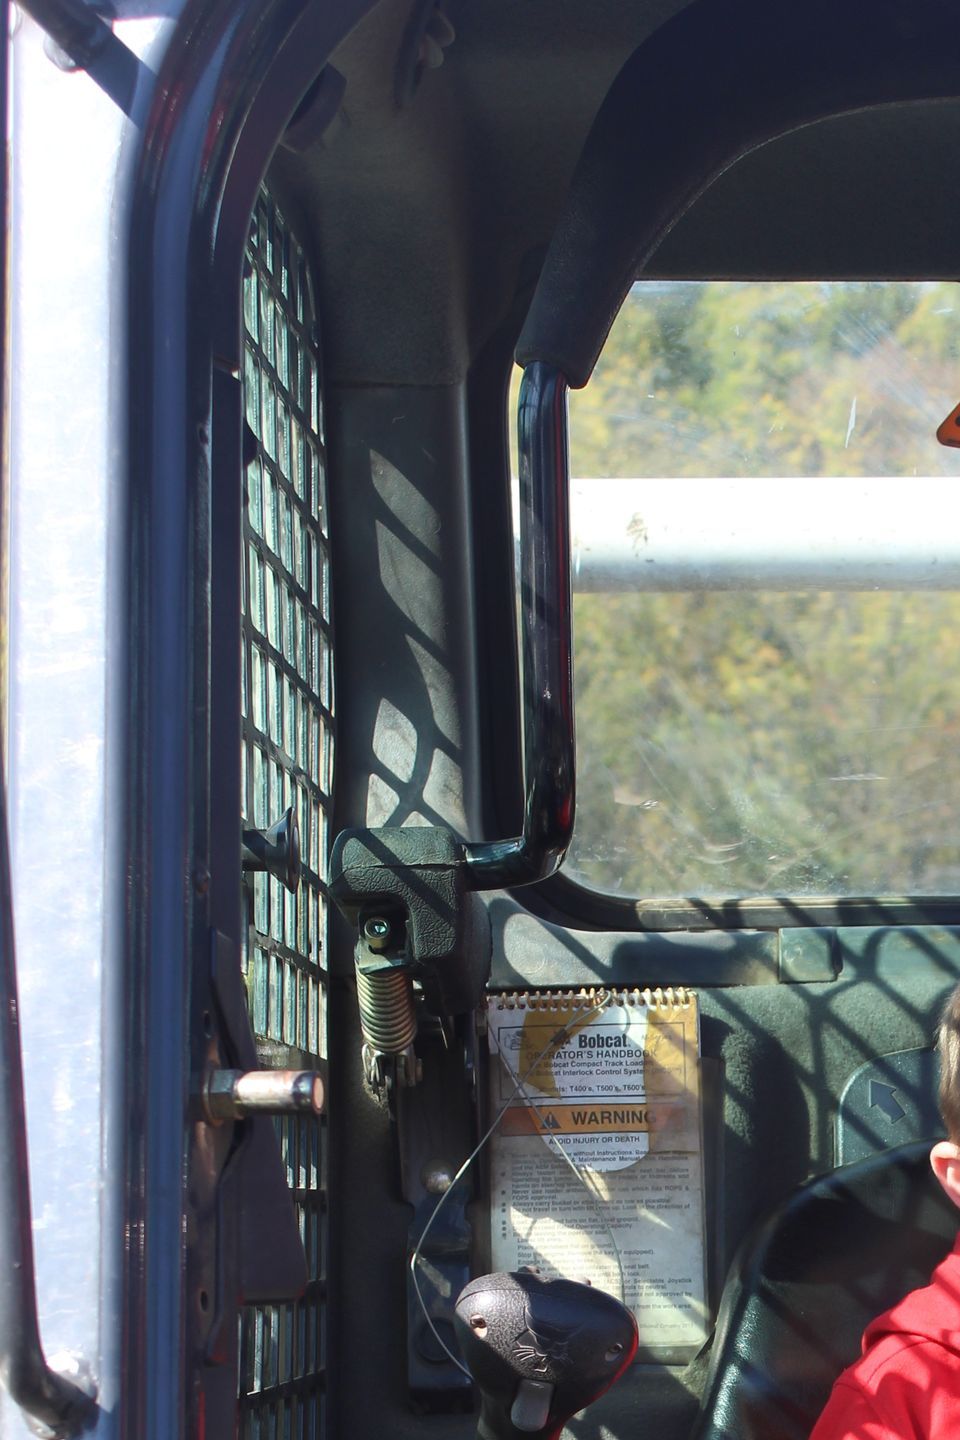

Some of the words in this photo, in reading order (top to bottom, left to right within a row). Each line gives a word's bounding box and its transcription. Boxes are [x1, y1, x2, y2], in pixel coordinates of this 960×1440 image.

[578, 1034, 627, 1048] Bobcat
[596, 1049, 656, 1059] HANDBOOK
[571, 1060, 602, 1070] Compact
[563, 1069, 594, 1077] Interlock
[596, 1068, 622, 1076] Control
[624, 1068, 649, 1077] Syste
[572, 1110, 657, 1126] WARNING
[574, 1137, 601, 1145] INJURY
[601, 1136, 614, 1144] OR
[615, 1135, 641, 1143] DEATH
